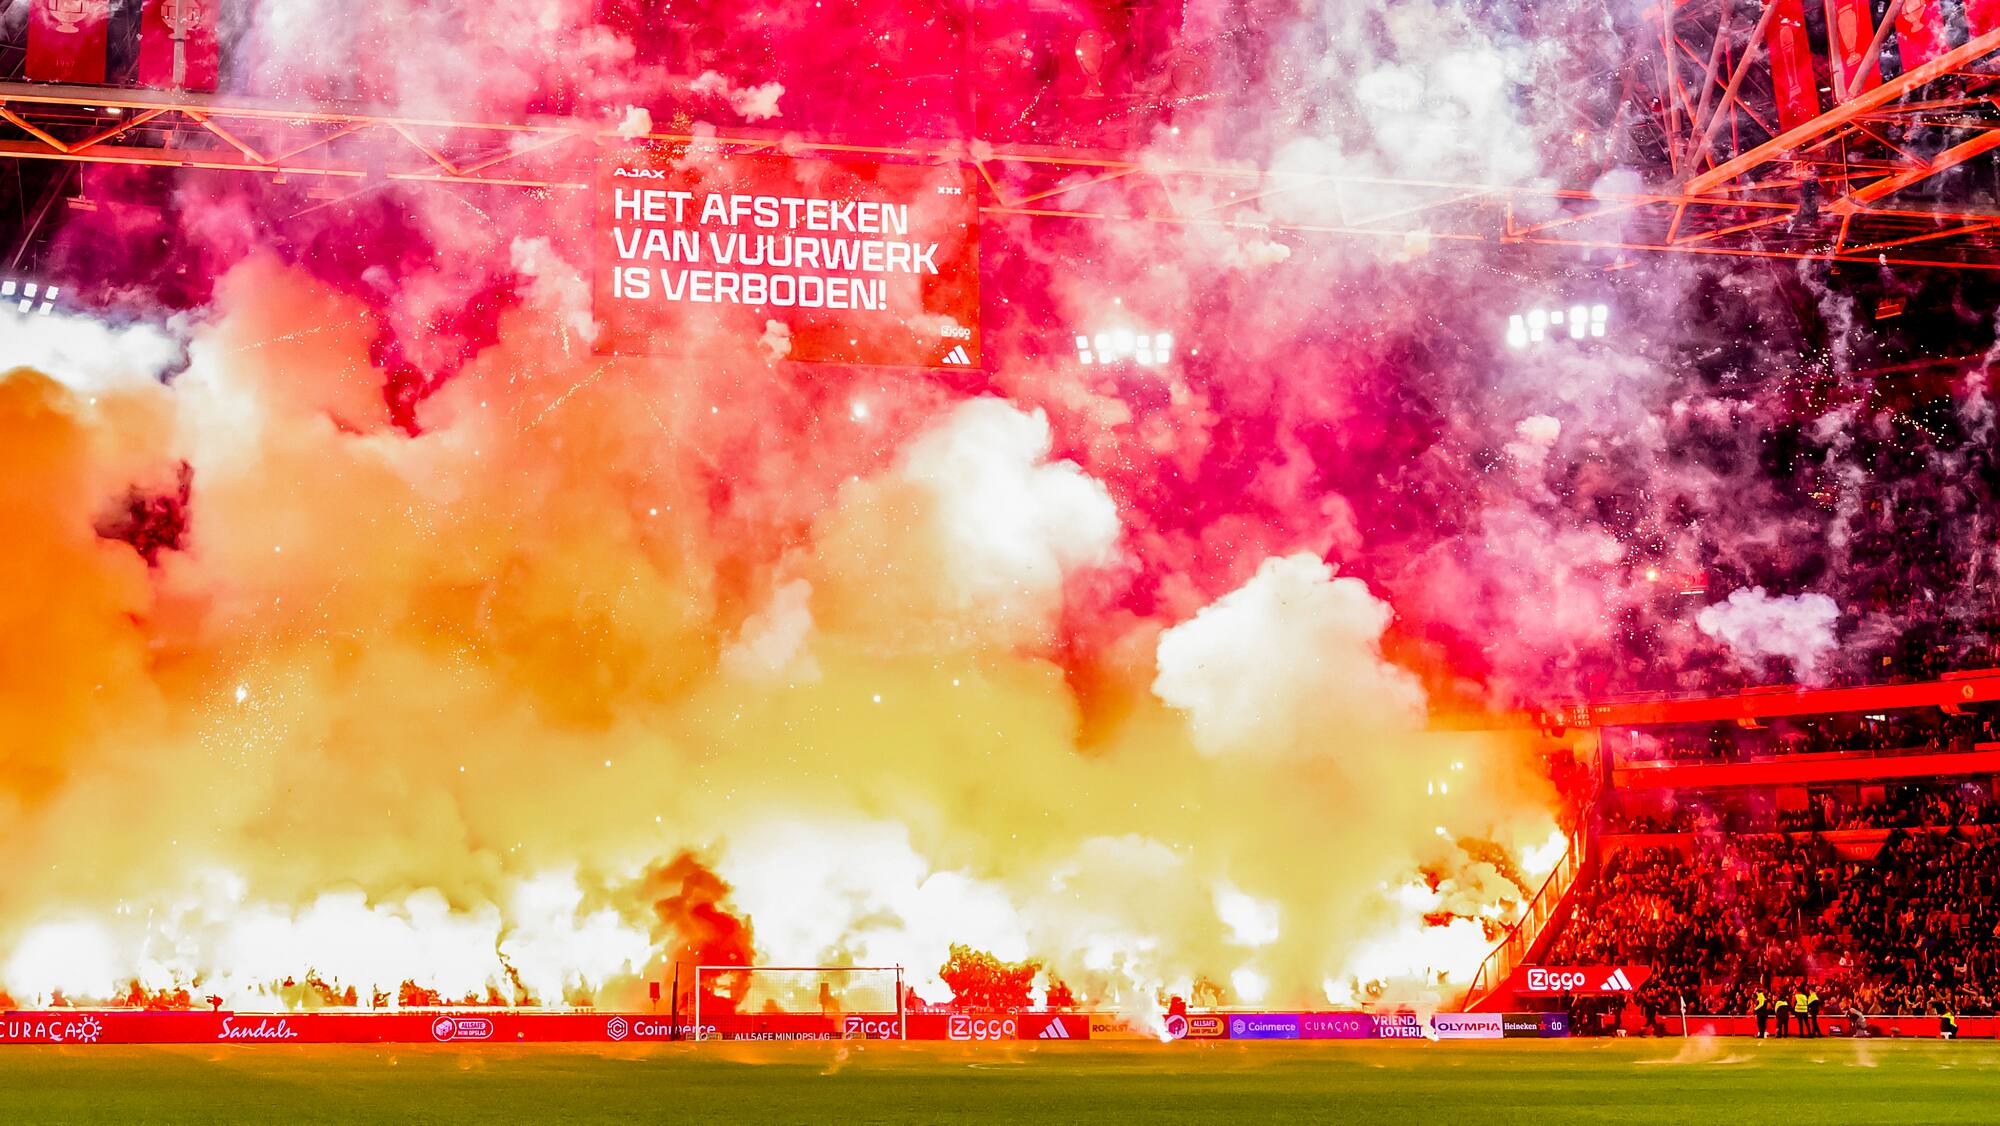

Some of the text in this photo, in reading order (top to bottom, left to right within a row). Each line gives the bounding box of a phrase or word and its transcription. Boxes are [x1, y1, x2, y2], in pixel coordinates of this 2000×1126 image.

[613, 168, 665, 179] AJAX
[614, 188, 908, 235] HET AFSTEKEN
[614, 228, 939, 275] VAN VUURWERK
[614, 267, 887, 310] IS VERBODEN!
[1372, 1015, 1420, 1026] VRIEND
[1504, 1022, 1537, 1030] Heineken
[218, 1017, 298, 1038] Sandals
[1093, 1024, 1129, 1033] ROCKST
[1248, 1022, 1296, 1031] Coinmerce
[1437, 1022, 1500, 1031] OLYMPIA
